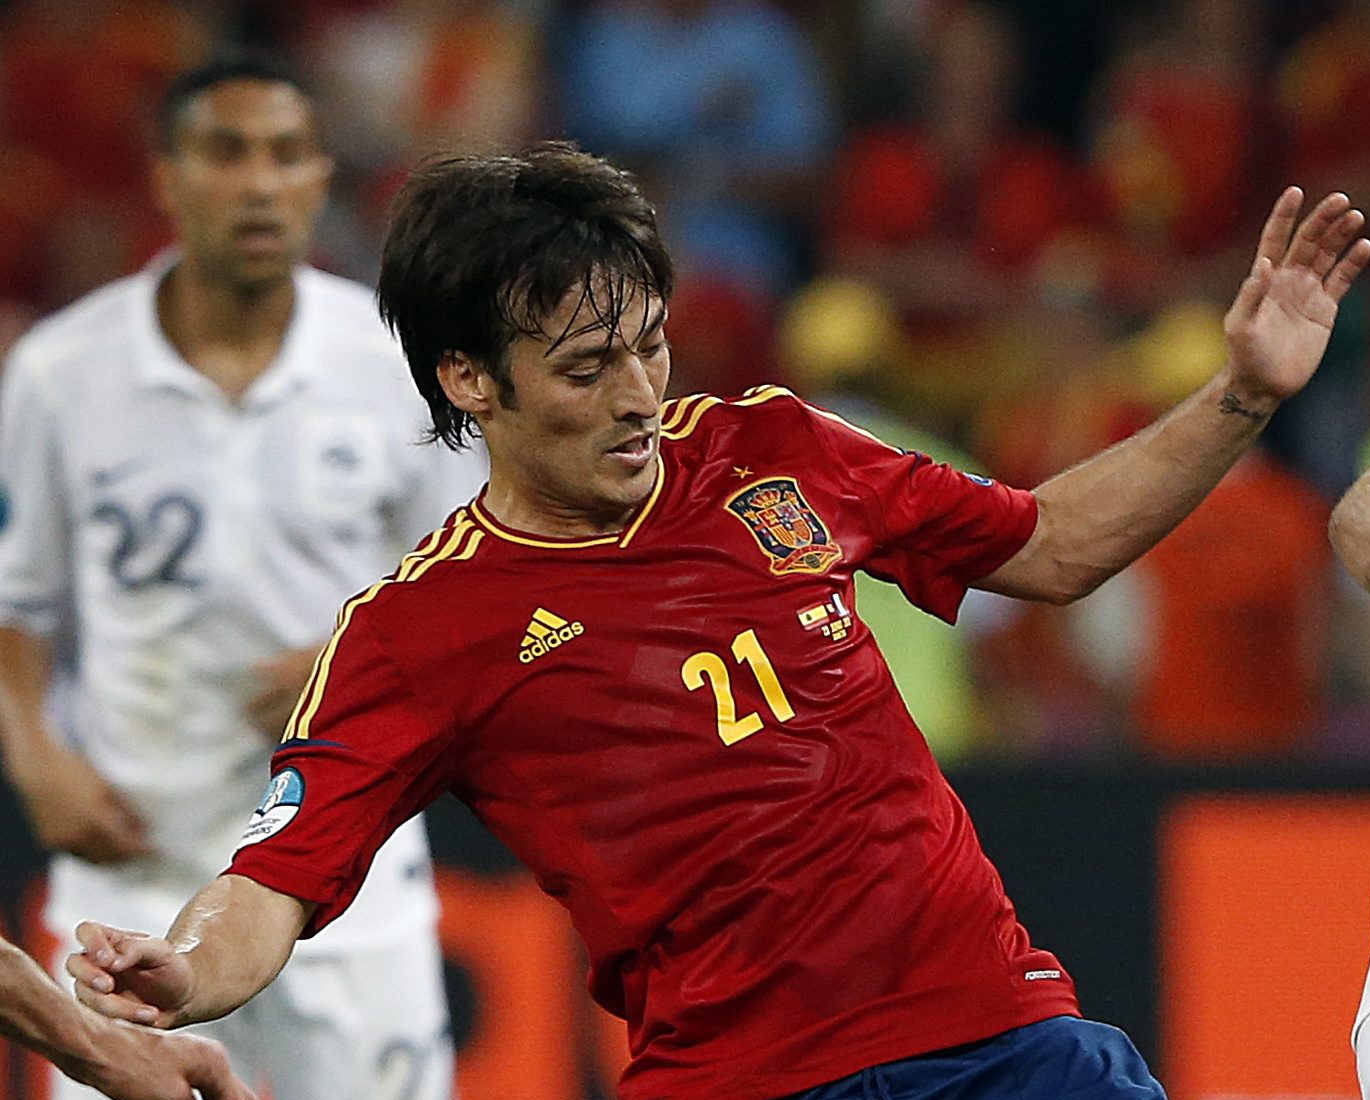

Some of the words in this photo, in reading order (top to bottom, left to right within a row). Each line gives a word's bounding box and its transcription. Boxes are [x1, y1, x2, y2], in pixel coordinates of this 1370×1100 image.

[91, 487, 205, 590] 22
[519, 621, 585, 664] adidas
[681, 628, 796, 746] 21
